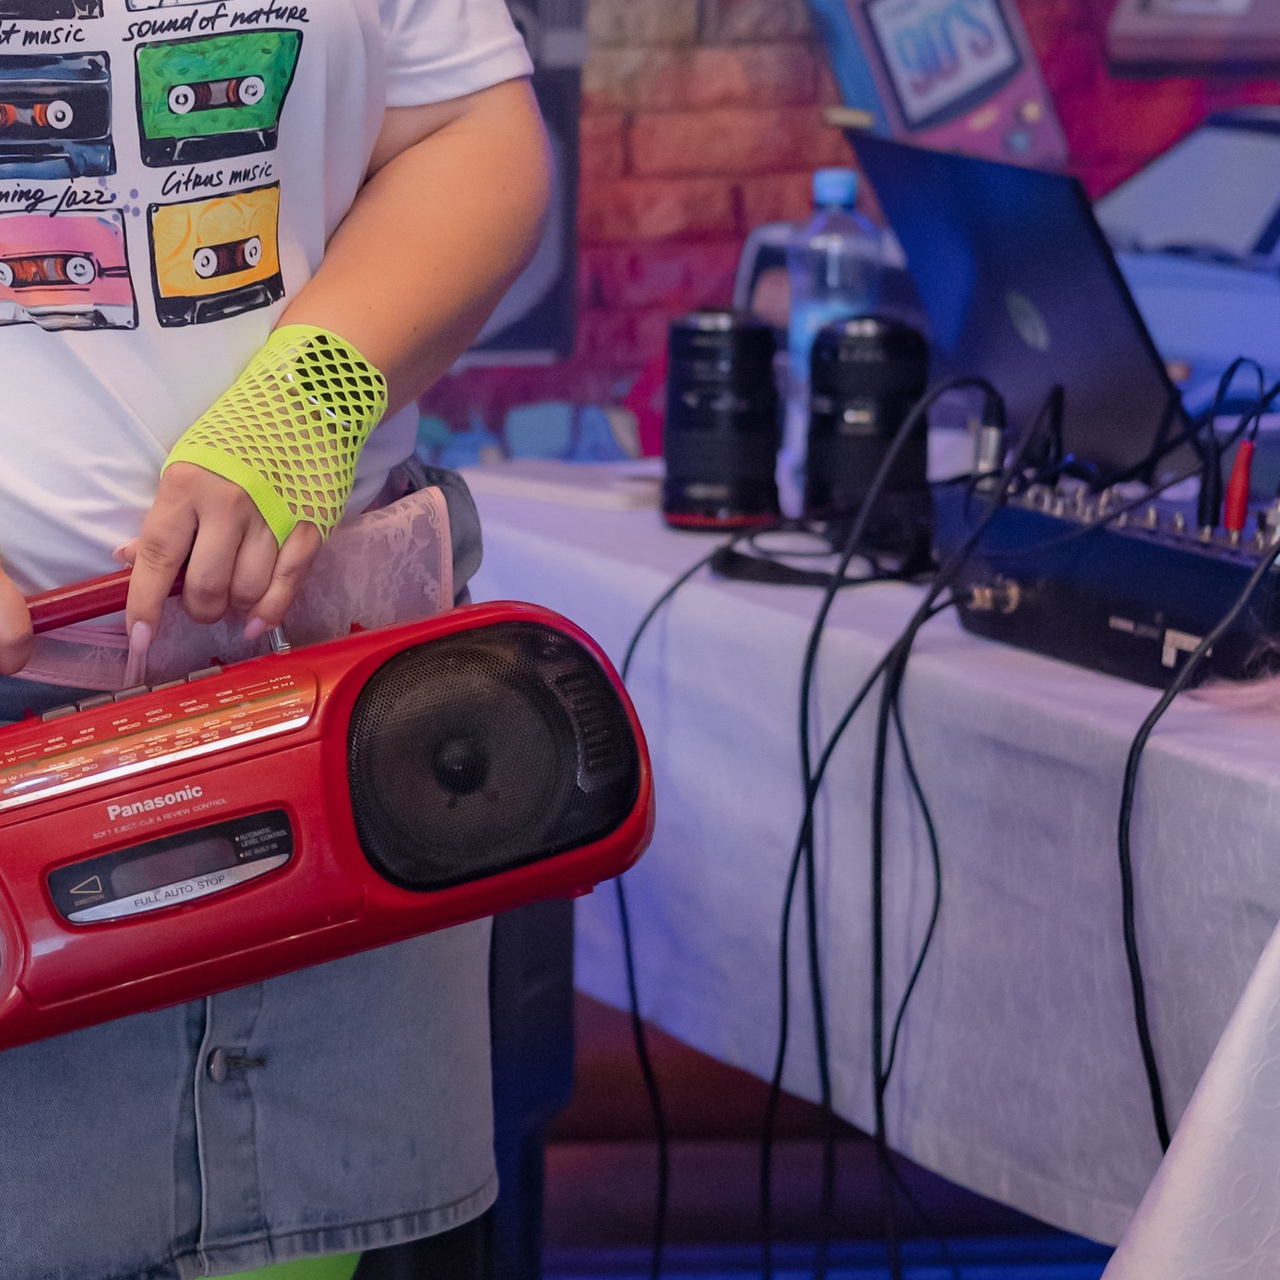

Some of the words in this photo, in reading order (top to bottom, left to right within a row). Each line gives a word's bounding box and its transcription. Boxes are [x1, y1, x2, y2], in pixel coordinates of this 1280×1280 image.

[21, 25, 87, 46] music
[121, 8, 199, 43] sound
[198, 2, 229, 32] of
[228, 160, 274, 189] music
[48, 177, 116, 218] jazz
[106, 784, 203, 821] Panasonic
[133, 894, 161, 908] FULL
[164, 884, 194, 900] AUTO
[197, 874, 226, 890] STOP
